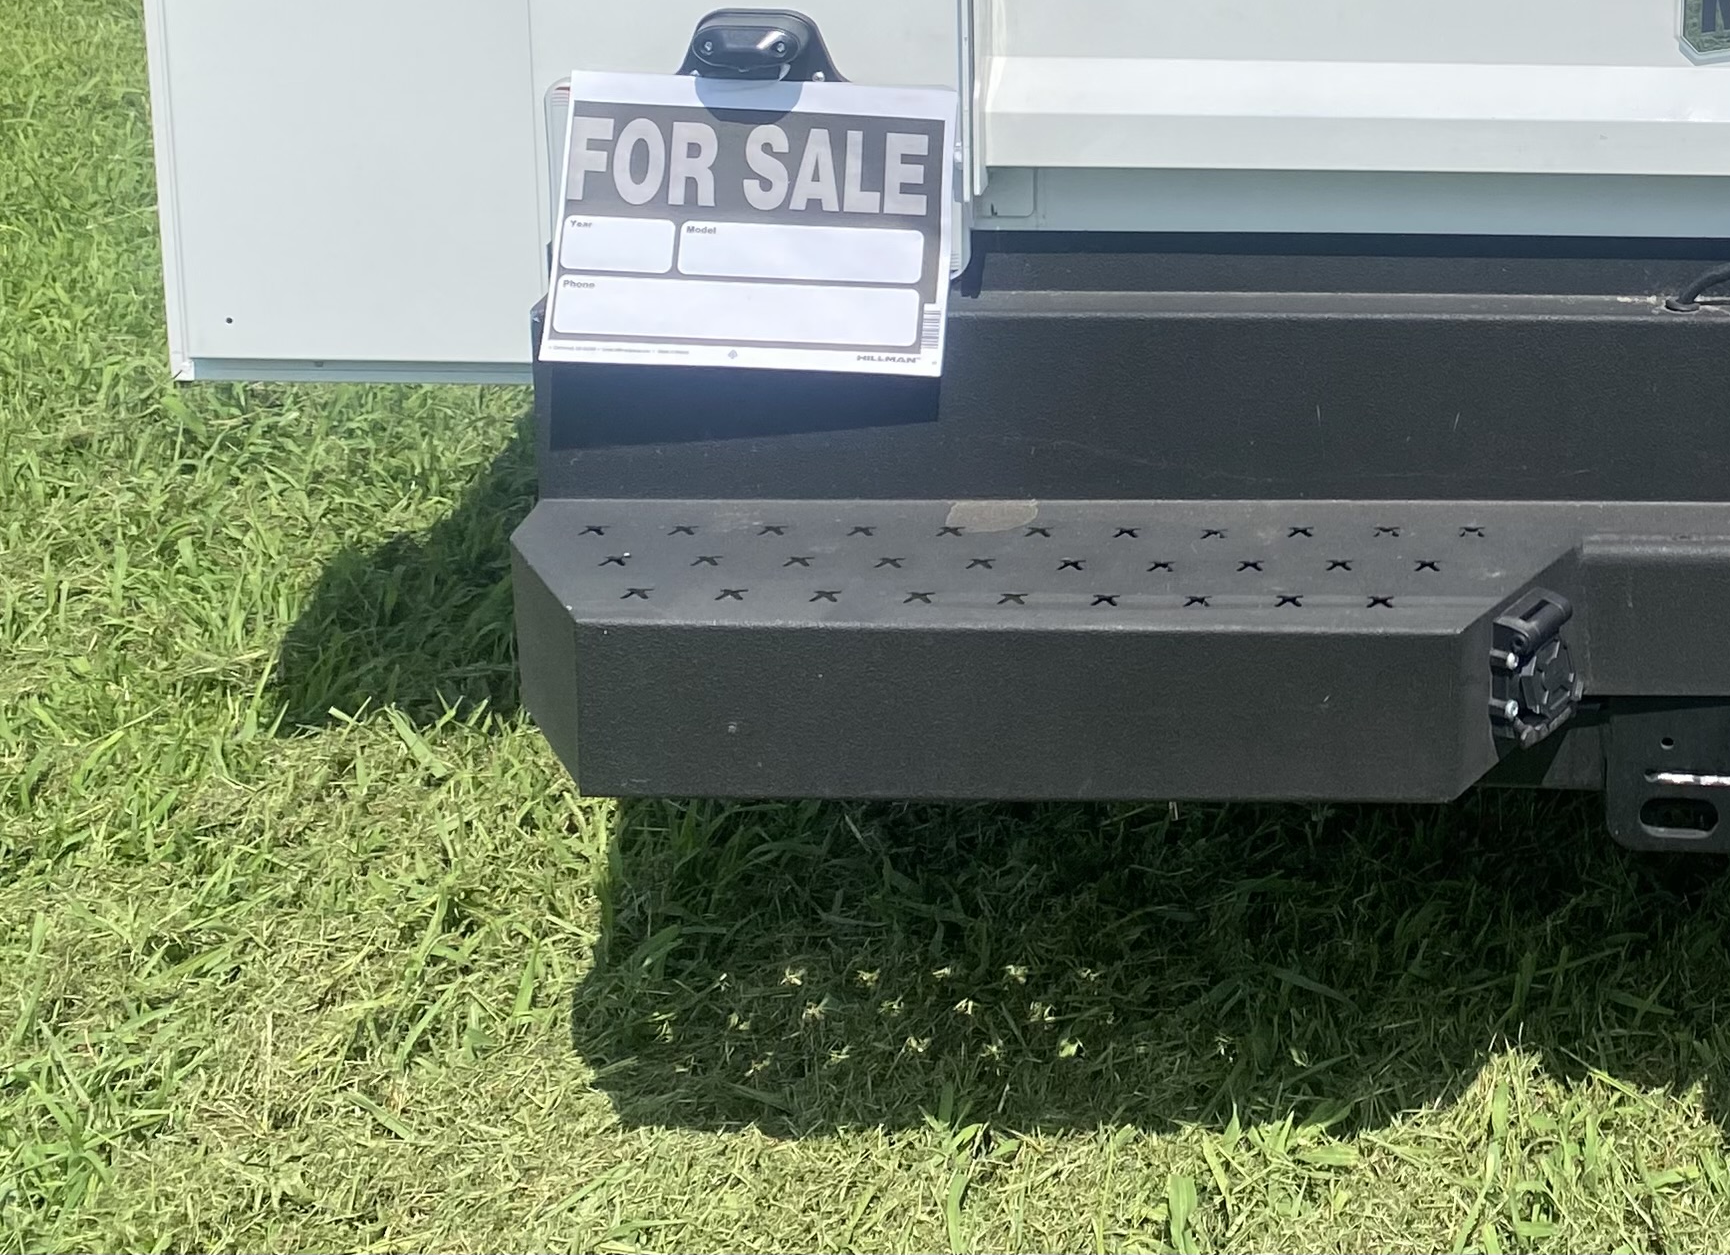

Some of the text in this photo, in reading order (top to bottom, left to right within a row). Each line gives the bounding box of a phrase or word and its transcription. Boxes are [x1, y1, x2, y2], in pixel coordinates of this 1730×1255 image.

[567, 116, 929, 216] FOR SALE
[570, 219, 593, 229] Year
[686, 225, 717, 235] Model
[562, 279, 596, 289] Phone
